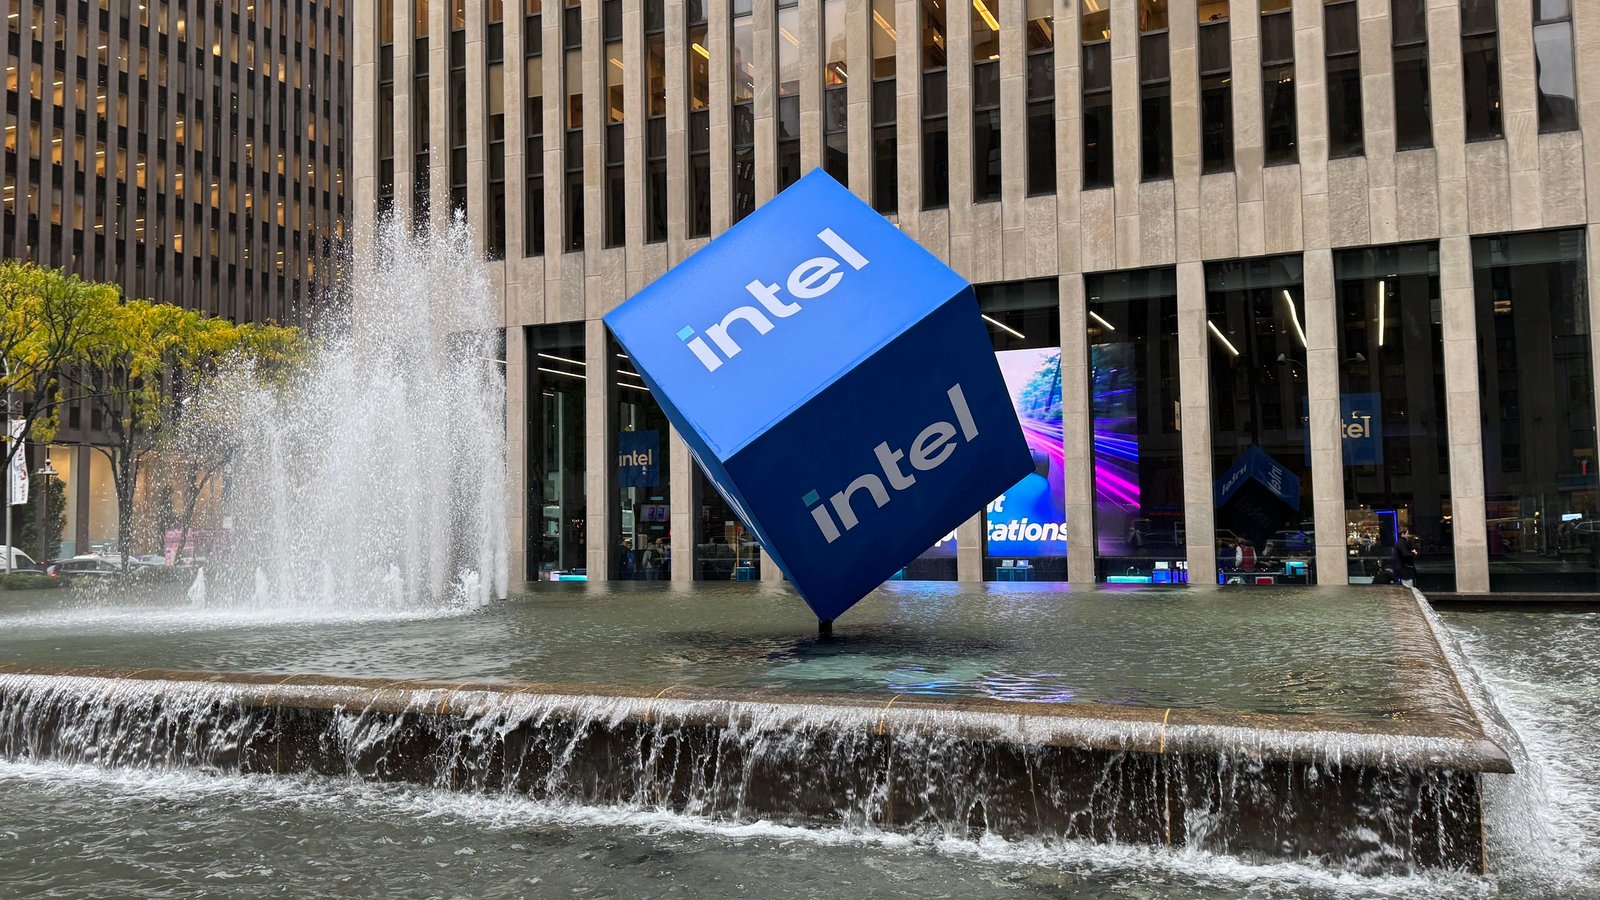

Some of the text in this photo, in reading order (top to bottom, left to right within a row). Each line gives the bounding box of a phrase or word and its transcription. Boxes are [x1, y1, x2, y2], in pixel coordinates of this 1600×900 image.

[676, 227, 869, 373] intel
[1341, 415, 1371, 439] tel
[618, 449, 652, 467] intel
[802, 383, 979, 544] intel
[987, 518, 1067, 541] tations
